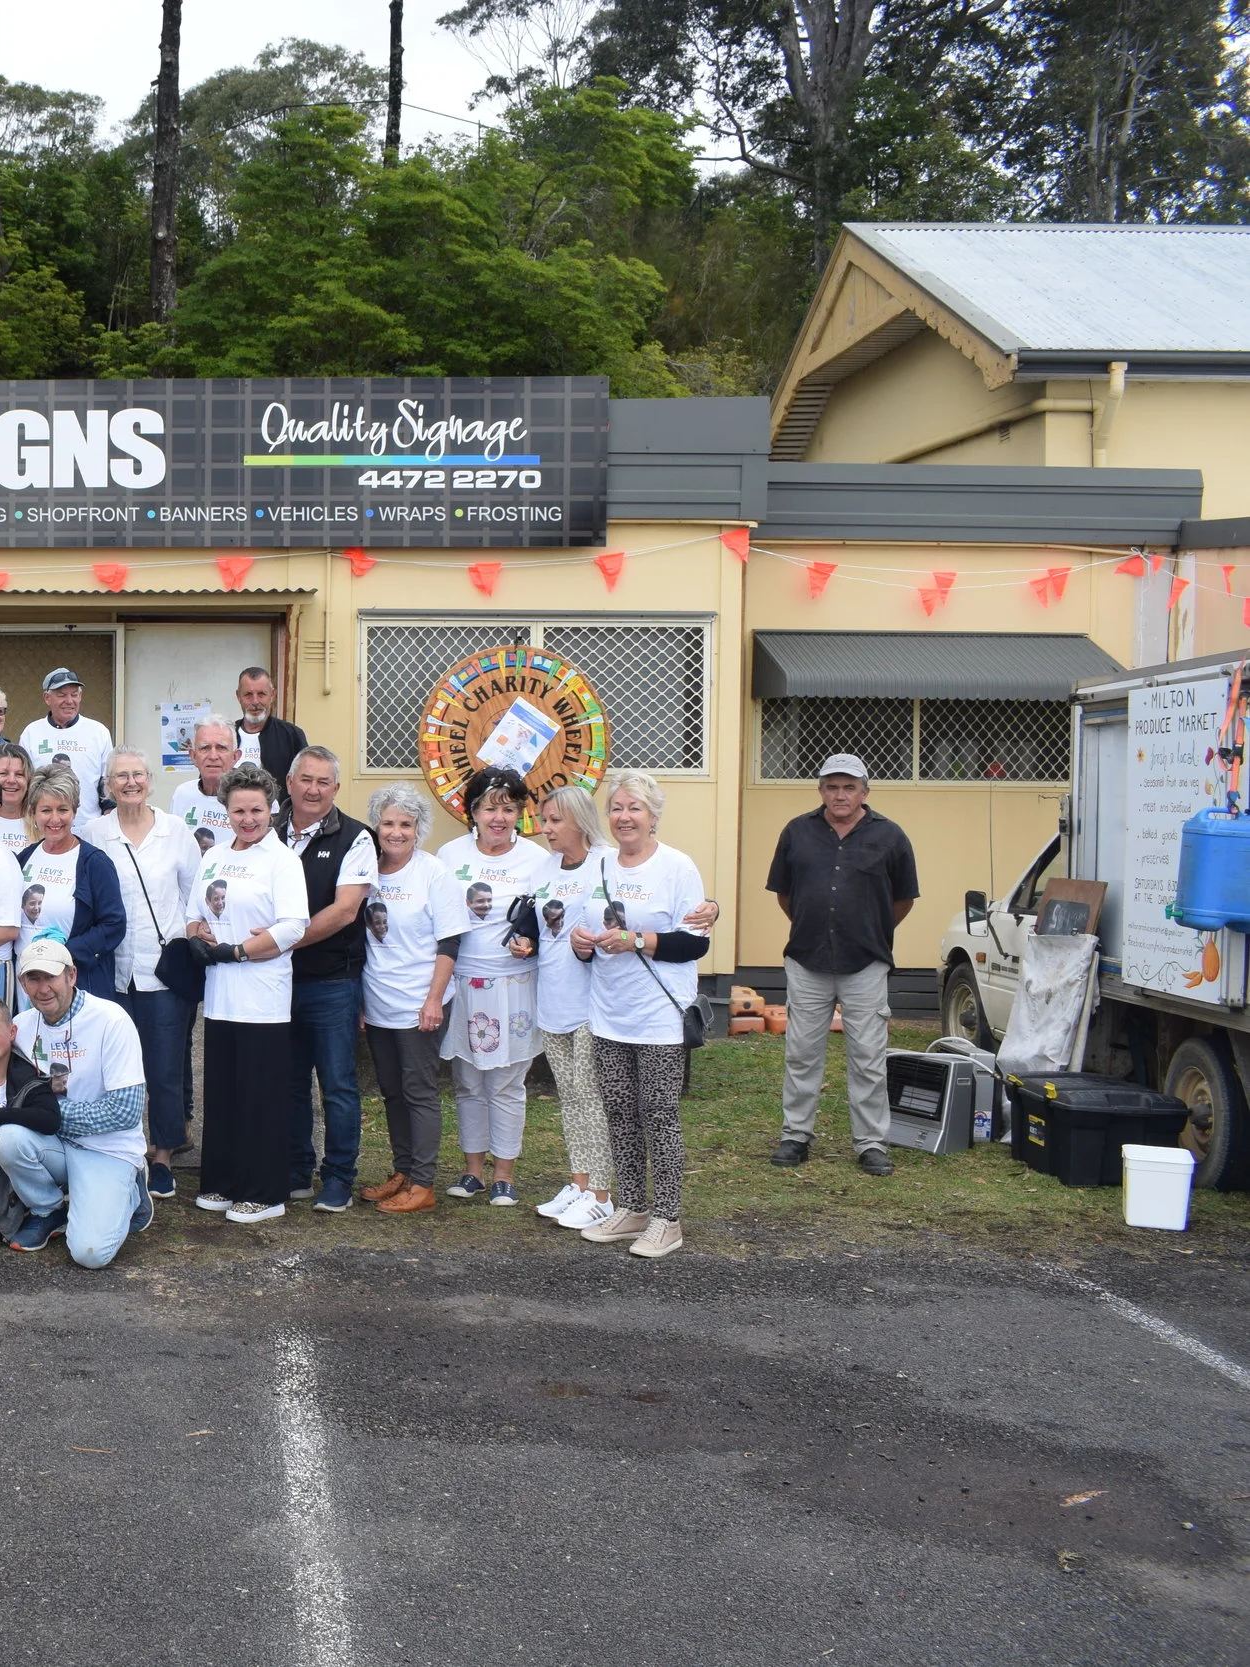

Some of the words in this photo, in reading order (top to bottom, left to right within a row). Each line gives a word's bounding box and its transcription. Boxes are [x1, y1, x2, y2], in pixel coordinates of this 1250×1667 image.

[261, 401, 388, 456] Quality
[392, 399, 527, 461] Signage
[358, 470, 445, 489] 4472
[453, 470, 541, 488] 2270
[26, 506, 140, 523] SHOPFRONT
[160, 506, 248, 522] BANNERS
[268, 505, 358, 522] VEHICLES
[378, 505, 447, 522] WRAPS
[467, 505, 562, 522] FROSTING
[1152, 688, 1195, 709] MILTON
[463, 676, 554, 713] CHARITY
[552, 698, 582, 765] WHEEL
[1136, 717, 1171, 736] PRODUCE
[1179, 713, 1217, 733] MARKET
[1151, 744, 1167, 771] fresh
[1178, 740, 1198, 767] local
[203, 810, 228, 821] LEVI'S
[202, 818, 232, 828] PROJEC
[39, 867, 64, 876] LEVI'S
[222, 864, 247, 872] LEVI'S
[37, 875, 72, 885] PROJECT
[219, 871, 255, 880] PROJECT
[1135, 878, 1164, 891] SATURDAYS
[1134, 893, 1141, 902] AT
[1144, 893, 1153, 904] THE
